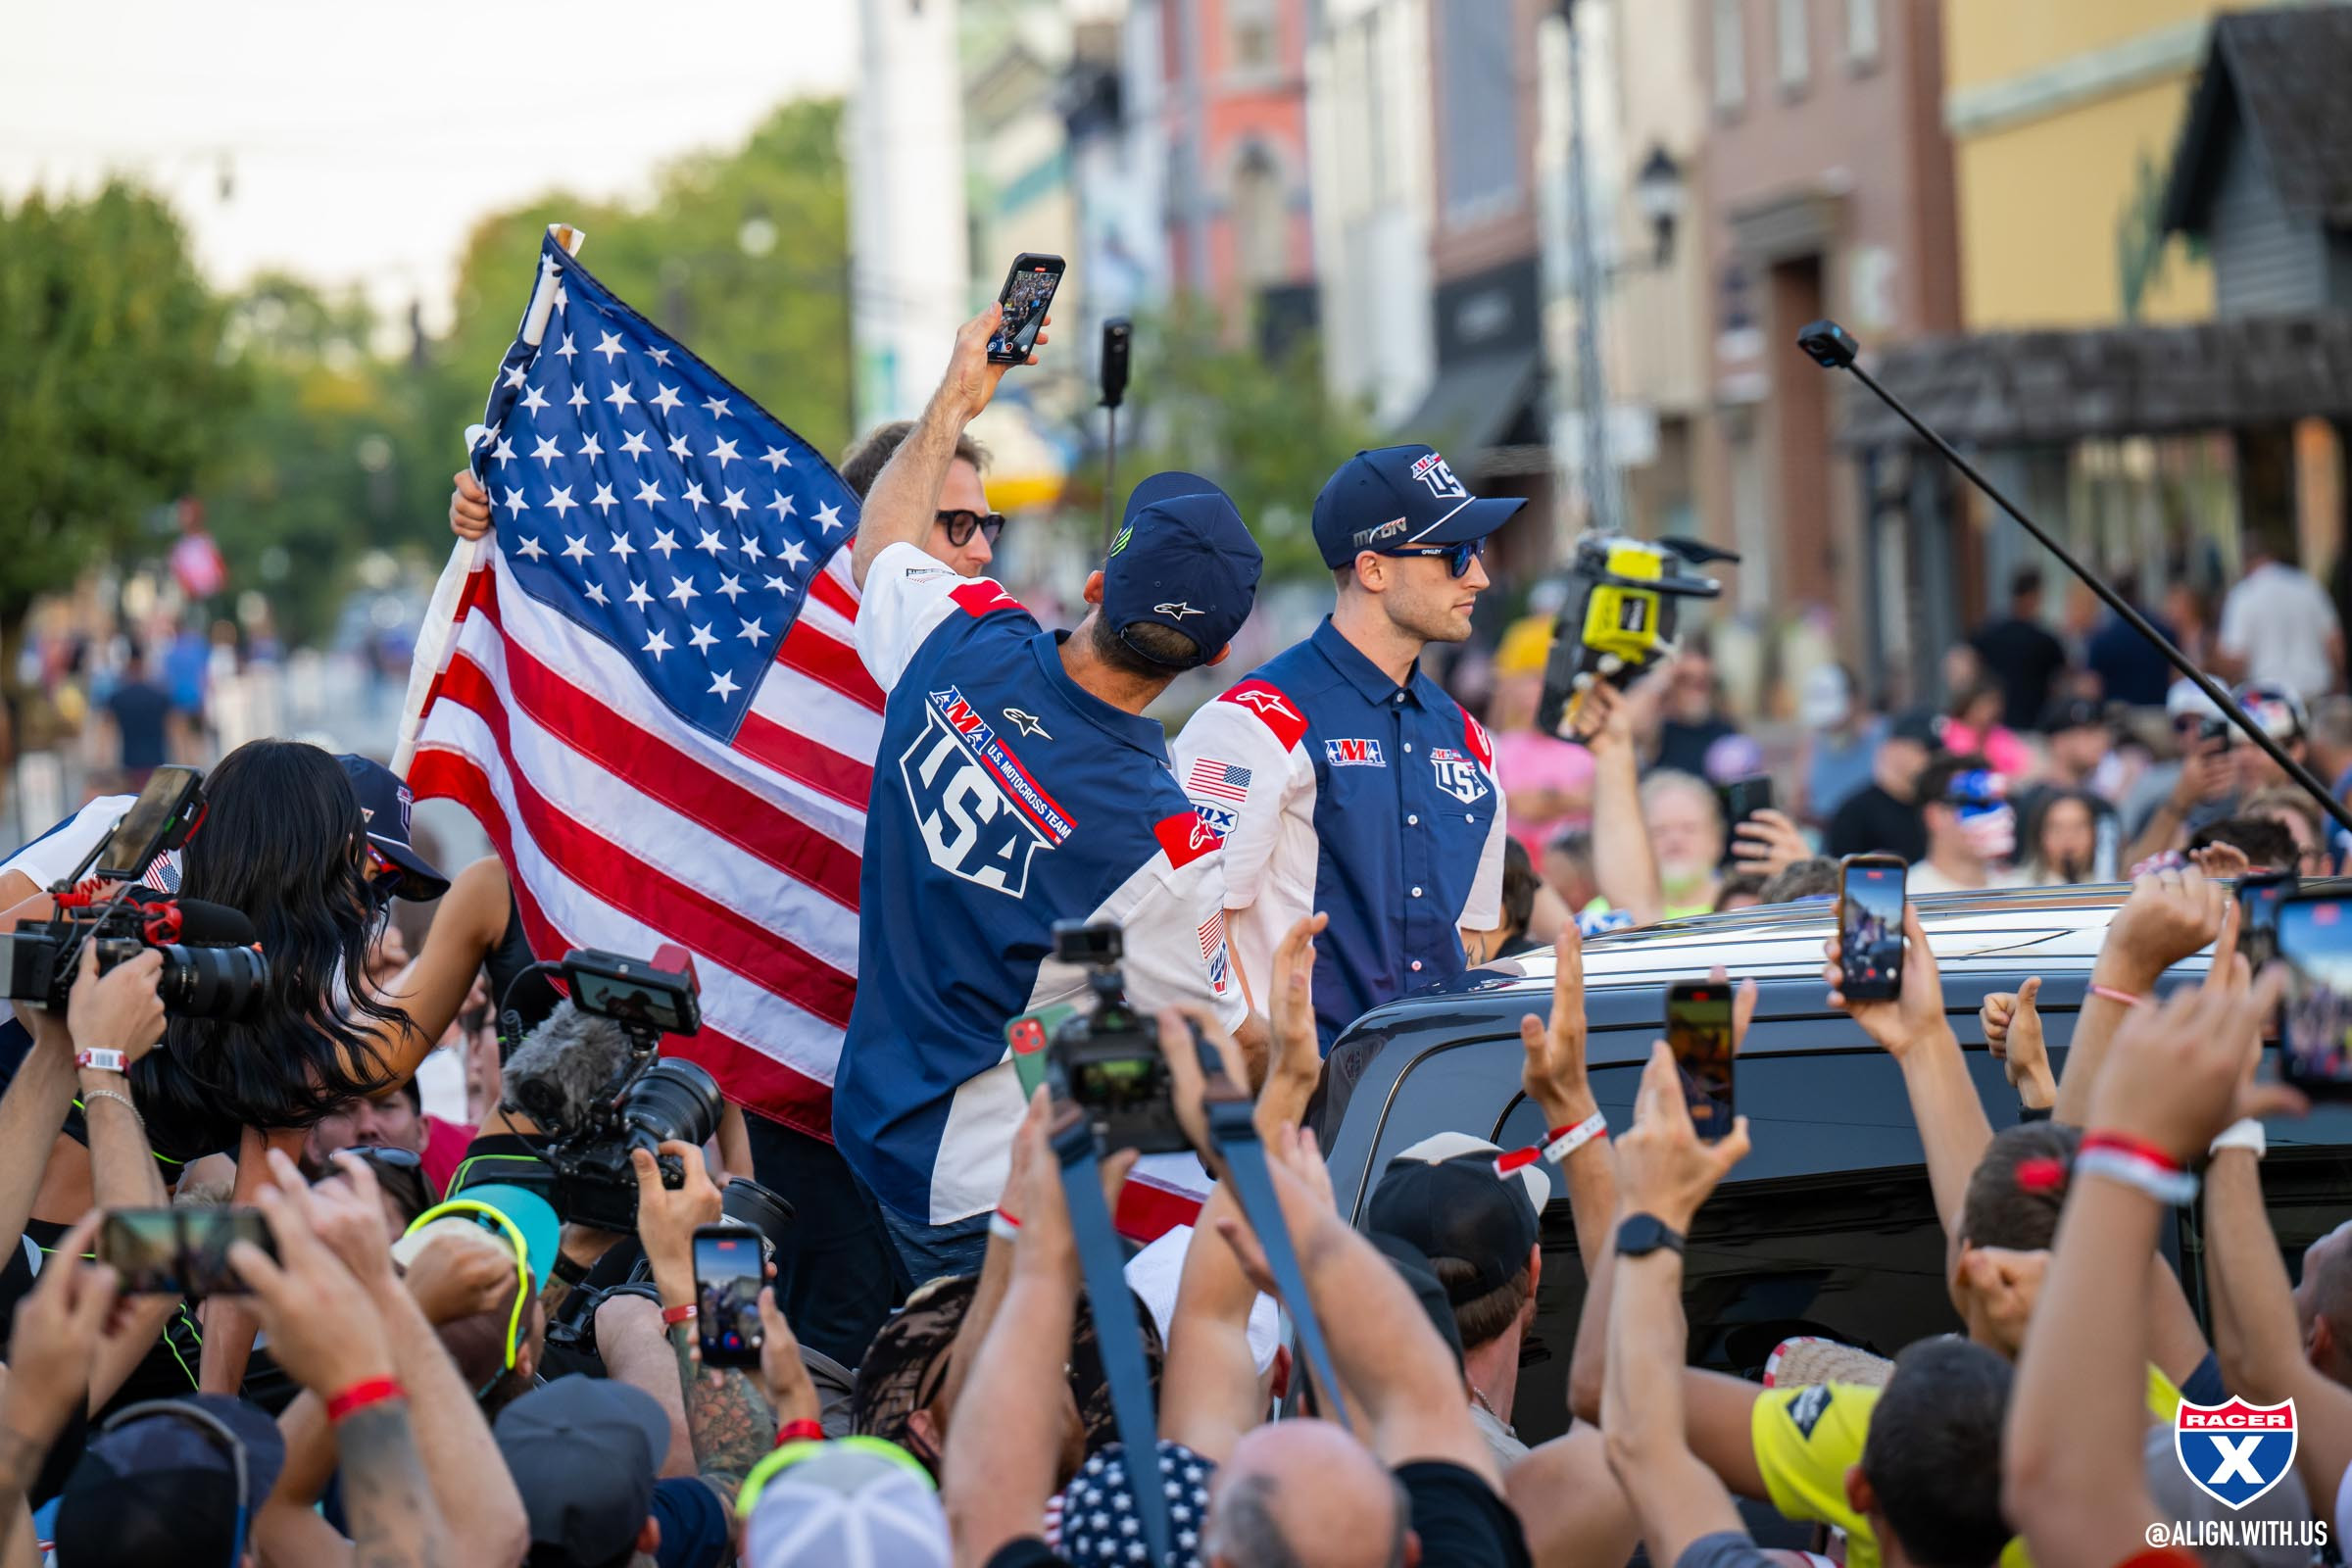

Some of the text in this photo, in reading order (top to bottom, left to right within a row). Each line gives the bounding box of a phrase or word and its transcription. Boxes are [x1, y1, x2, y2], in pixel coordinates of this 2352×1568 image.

[929, 684, 995, 756] AMA
[1325, 739, 1387, 766] AMA
[900, 702, 1049, 900] USA
[987, 743, 1072, 840] U.S. MOTOCROSS TEAM
